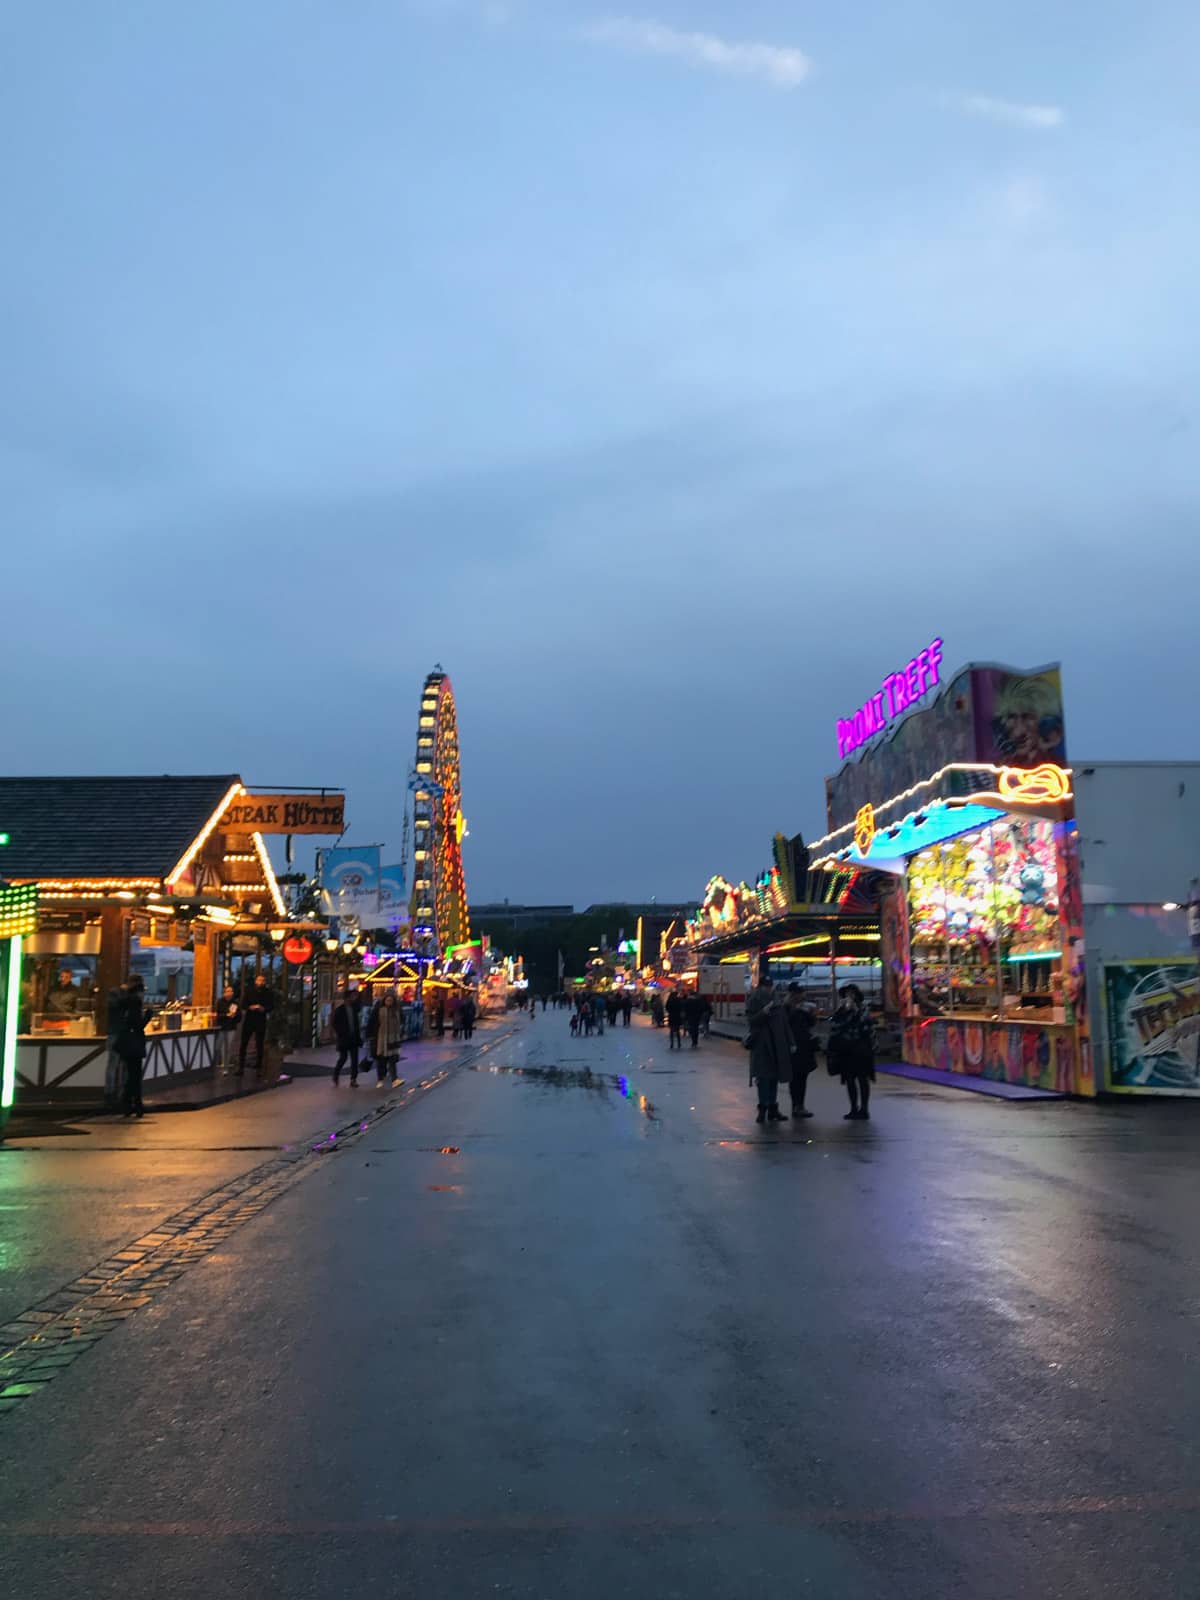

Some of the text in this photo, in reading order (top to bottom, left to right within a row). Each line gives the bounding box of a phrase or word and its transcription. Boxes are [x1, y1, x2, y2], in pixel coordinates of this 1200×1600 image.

[837, 638, 943, 759] PROMI TREFF
[220, 801, 343, 828] STEAK HÜTTE
